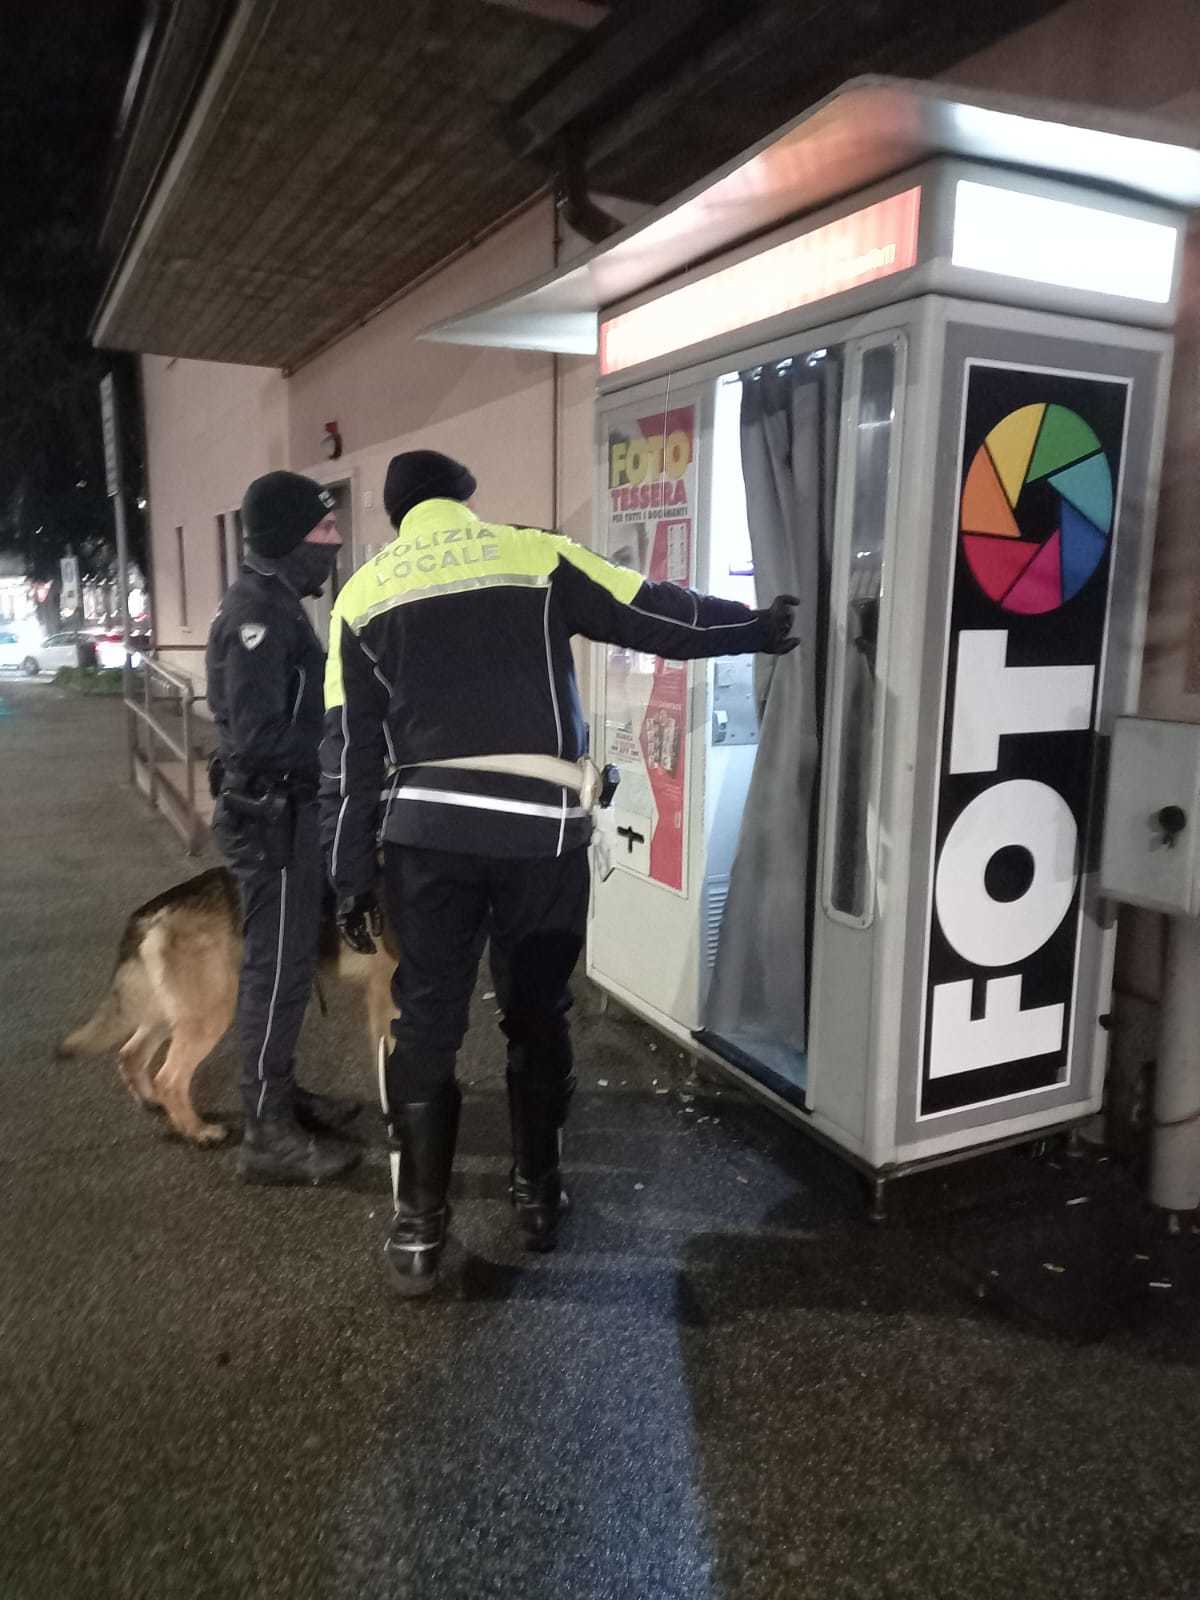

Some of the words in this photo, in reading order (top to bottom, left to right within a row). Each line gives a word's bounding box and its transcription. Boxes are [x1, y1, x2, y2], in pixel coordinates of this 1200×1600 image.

[611, 431, 689, 487] FOTO
[612, 480, 687, 511] TESSERA
[376, 527, 496, 562] POLIZIA
[377, 544, 501, 585] LOCALE
